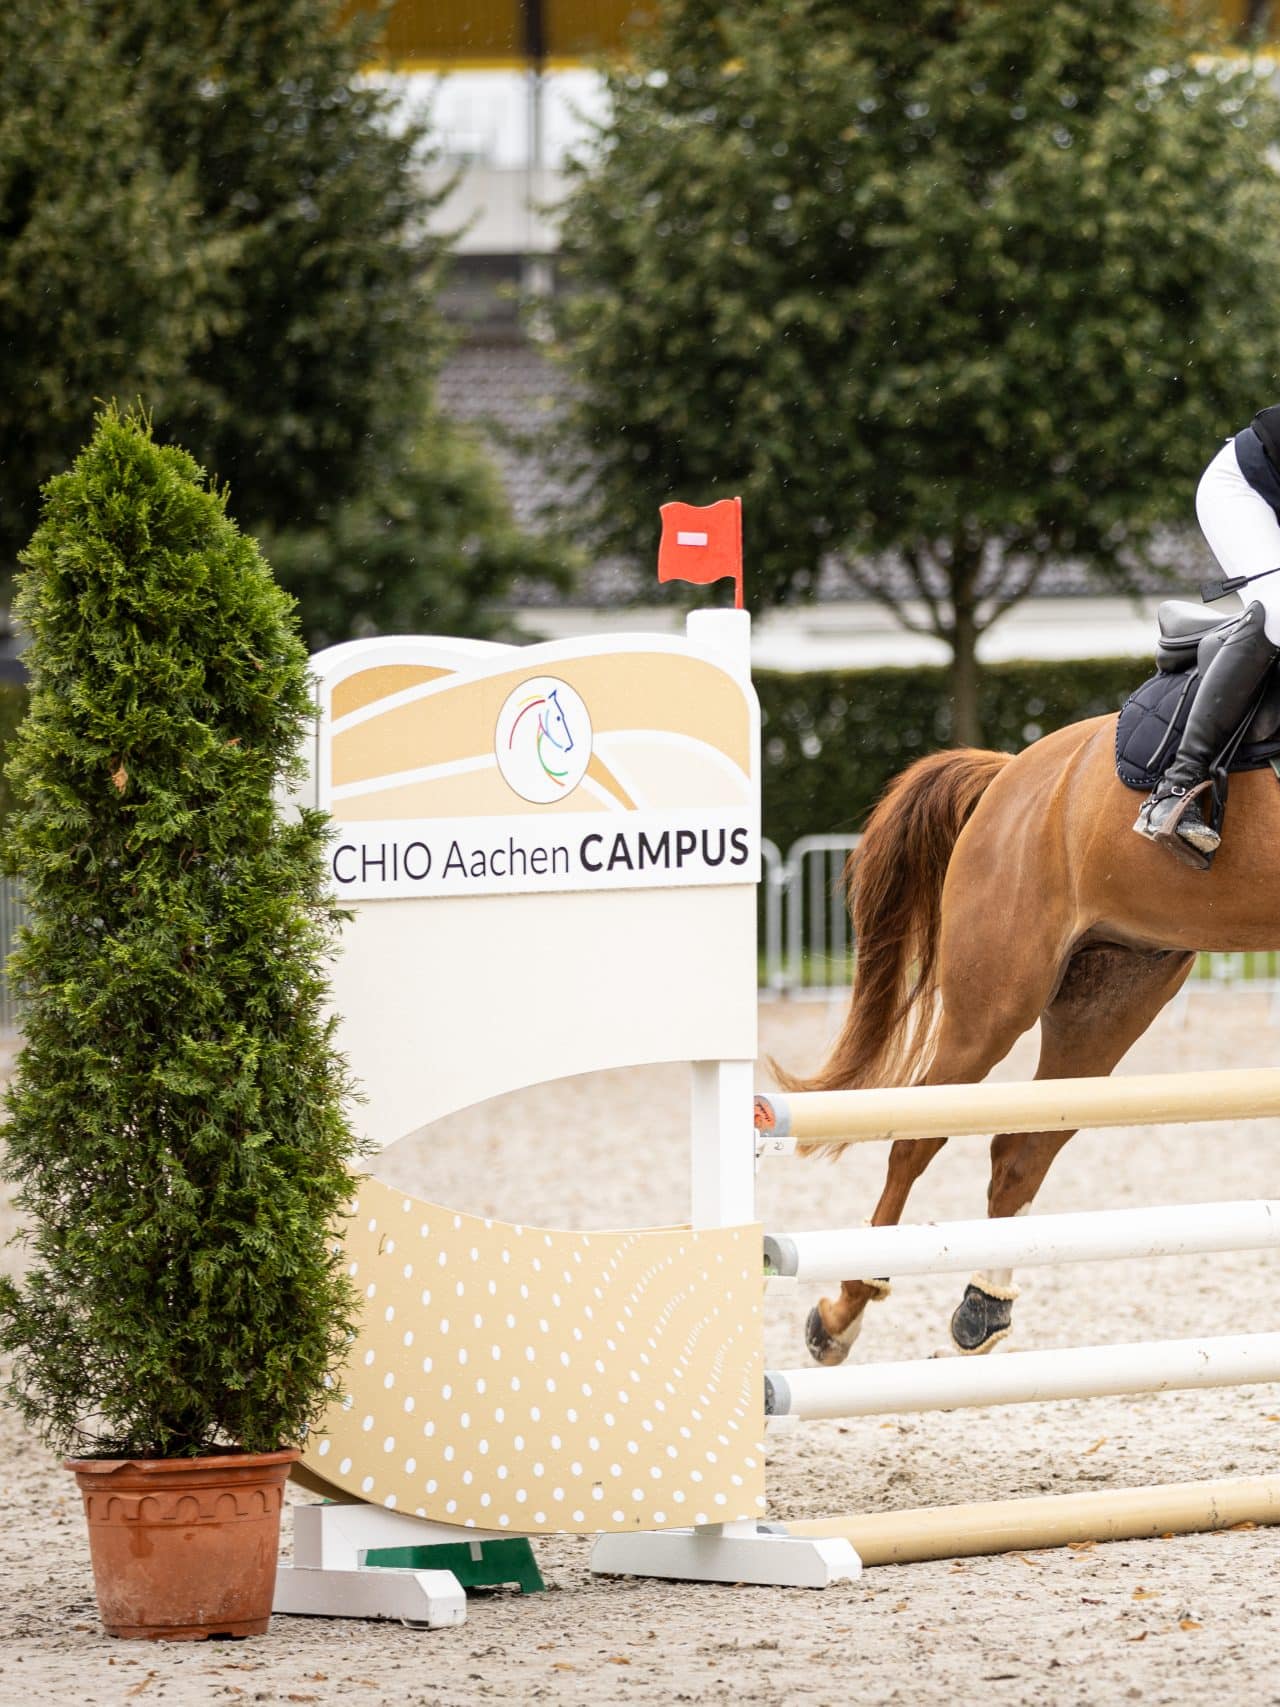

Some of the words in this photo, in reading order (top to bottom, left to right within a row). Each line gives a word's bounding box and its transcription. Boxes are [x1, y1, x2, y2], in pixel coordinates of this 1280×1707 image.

[332, 841, 433, 885] CHIO
[441, 836, 570, 880] Aachen
[579, 827, 750, 873] CAMPUS
